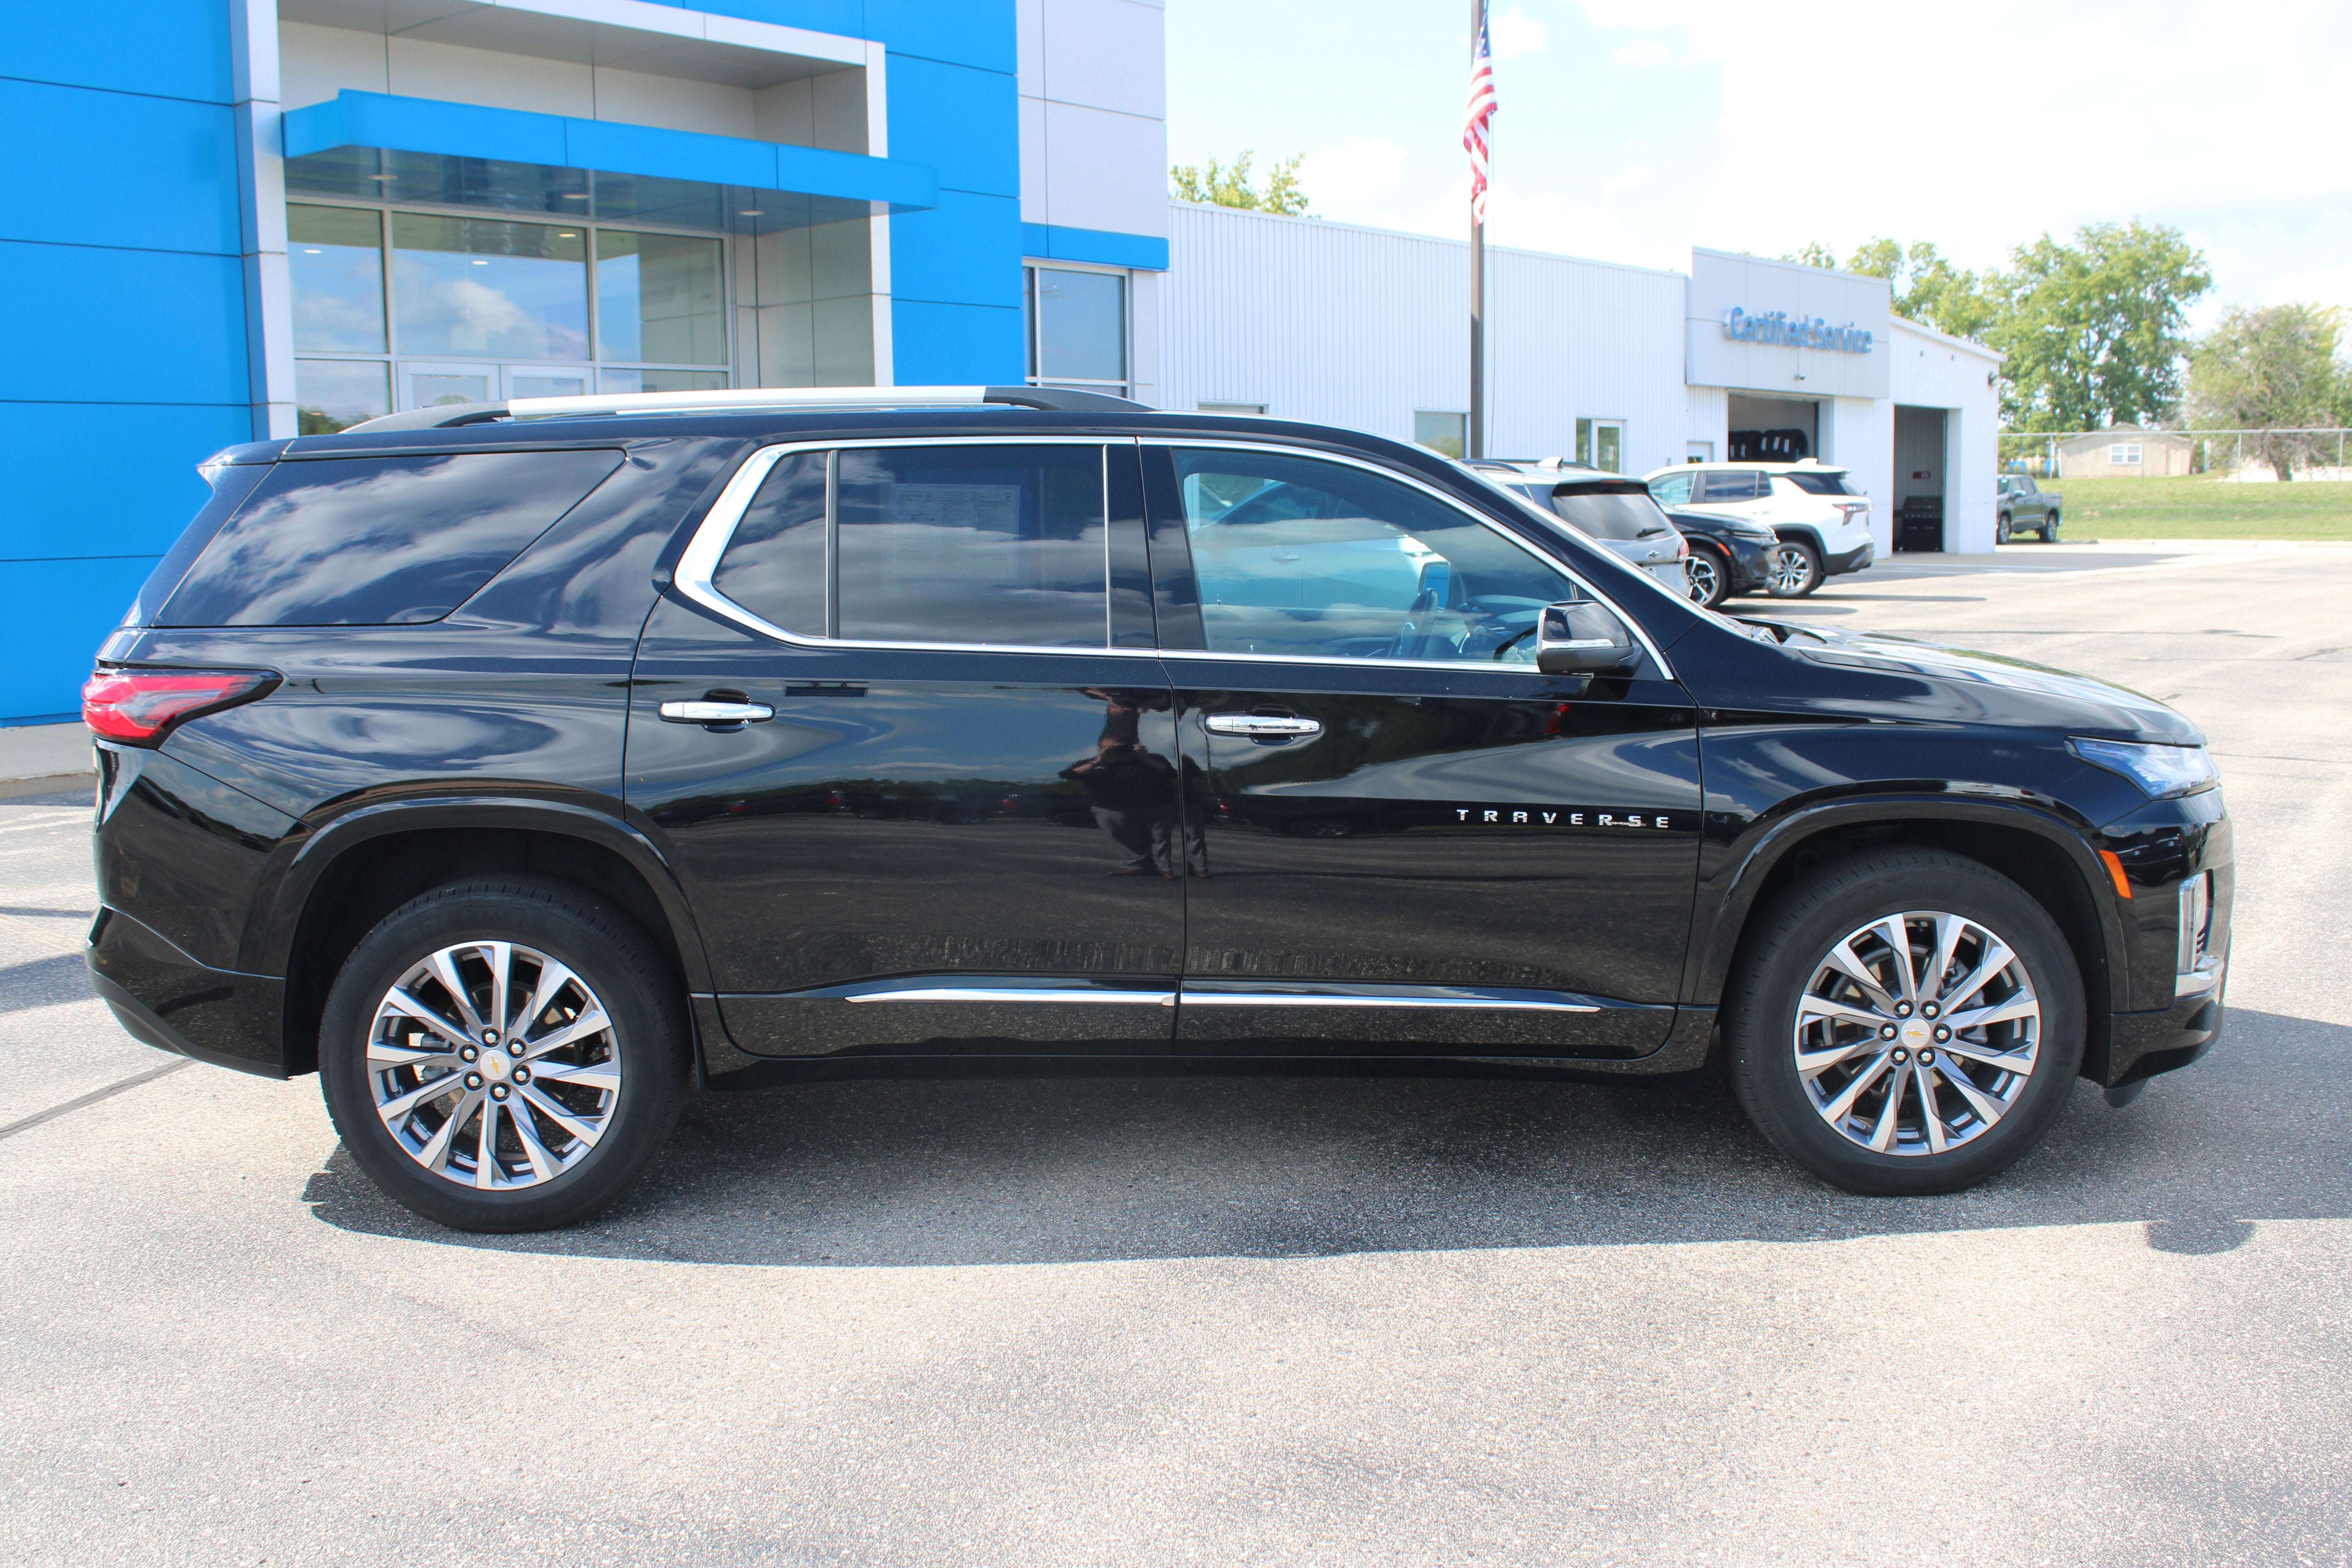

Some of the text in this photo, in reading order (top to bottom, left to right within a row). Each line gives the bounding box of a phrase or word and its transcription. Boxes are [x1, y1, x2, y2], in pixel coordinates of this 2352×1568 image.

[1729, 305, 1873, 353] Certified Service
[1456, 809, 1669, 828] TRAVERSE
